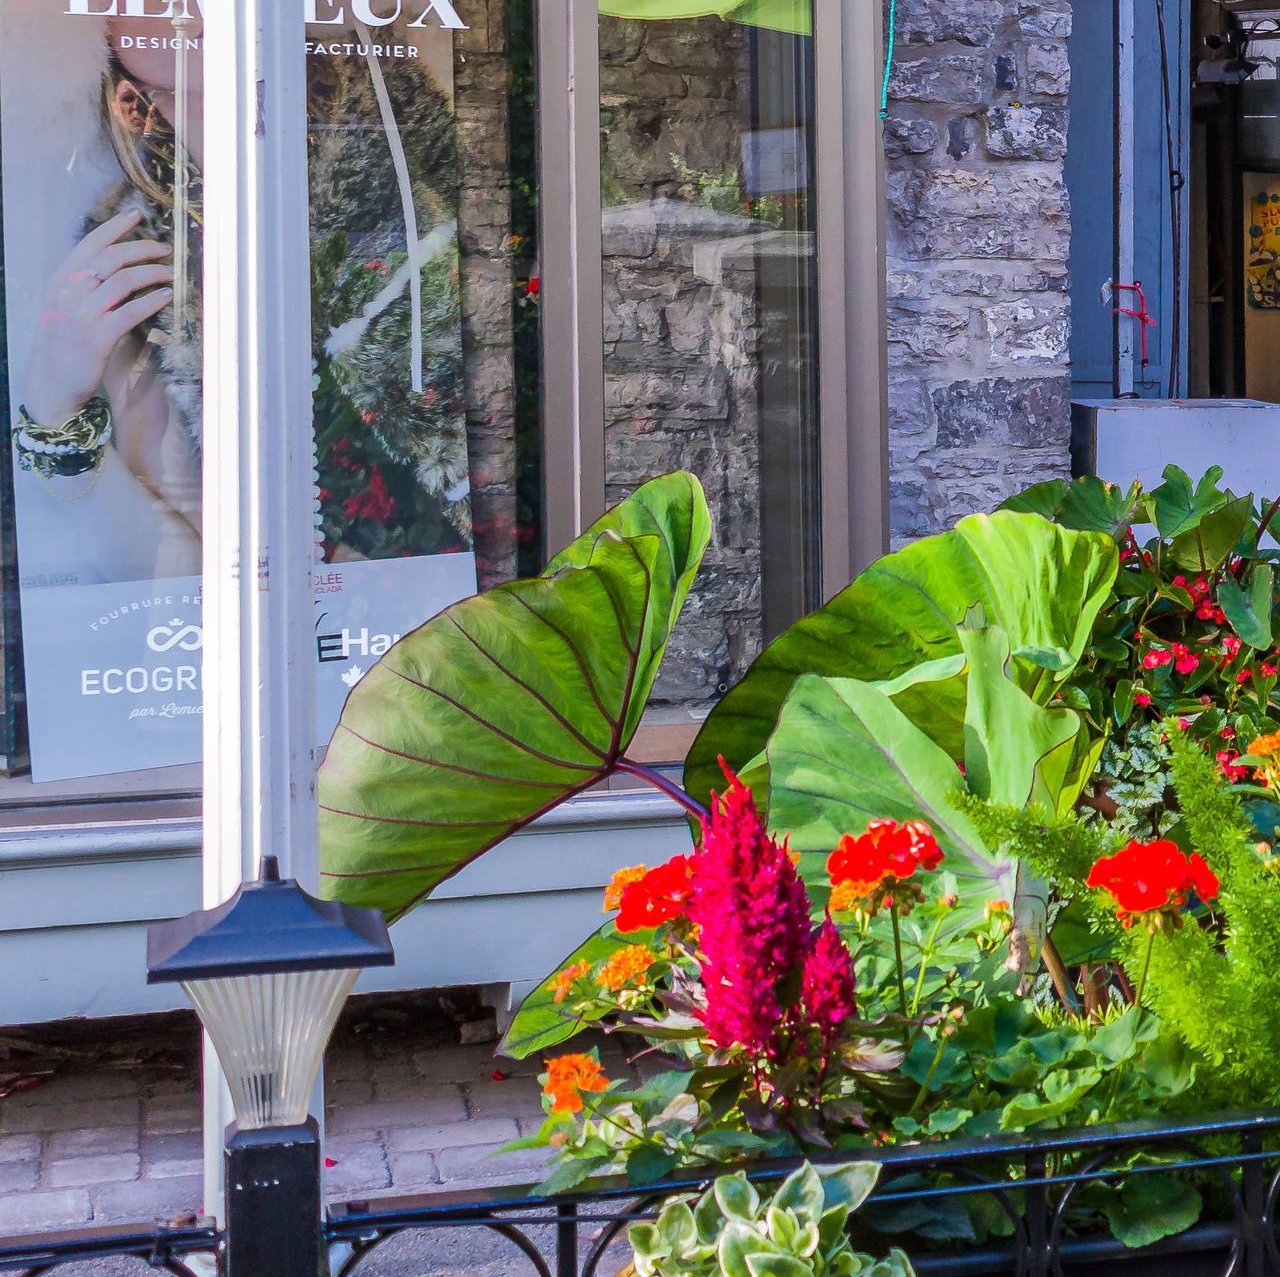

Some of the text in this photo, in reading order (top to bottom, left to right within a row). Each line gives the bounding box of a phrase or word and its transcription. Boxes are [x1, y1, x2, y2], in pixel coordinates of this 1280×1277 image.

[91, 596, 174, 631] FOURRURE
[342, 627, 400, 657] Ha
[81, 665, 204, 696] ECOGR
[128, 707, 157, 720] par
